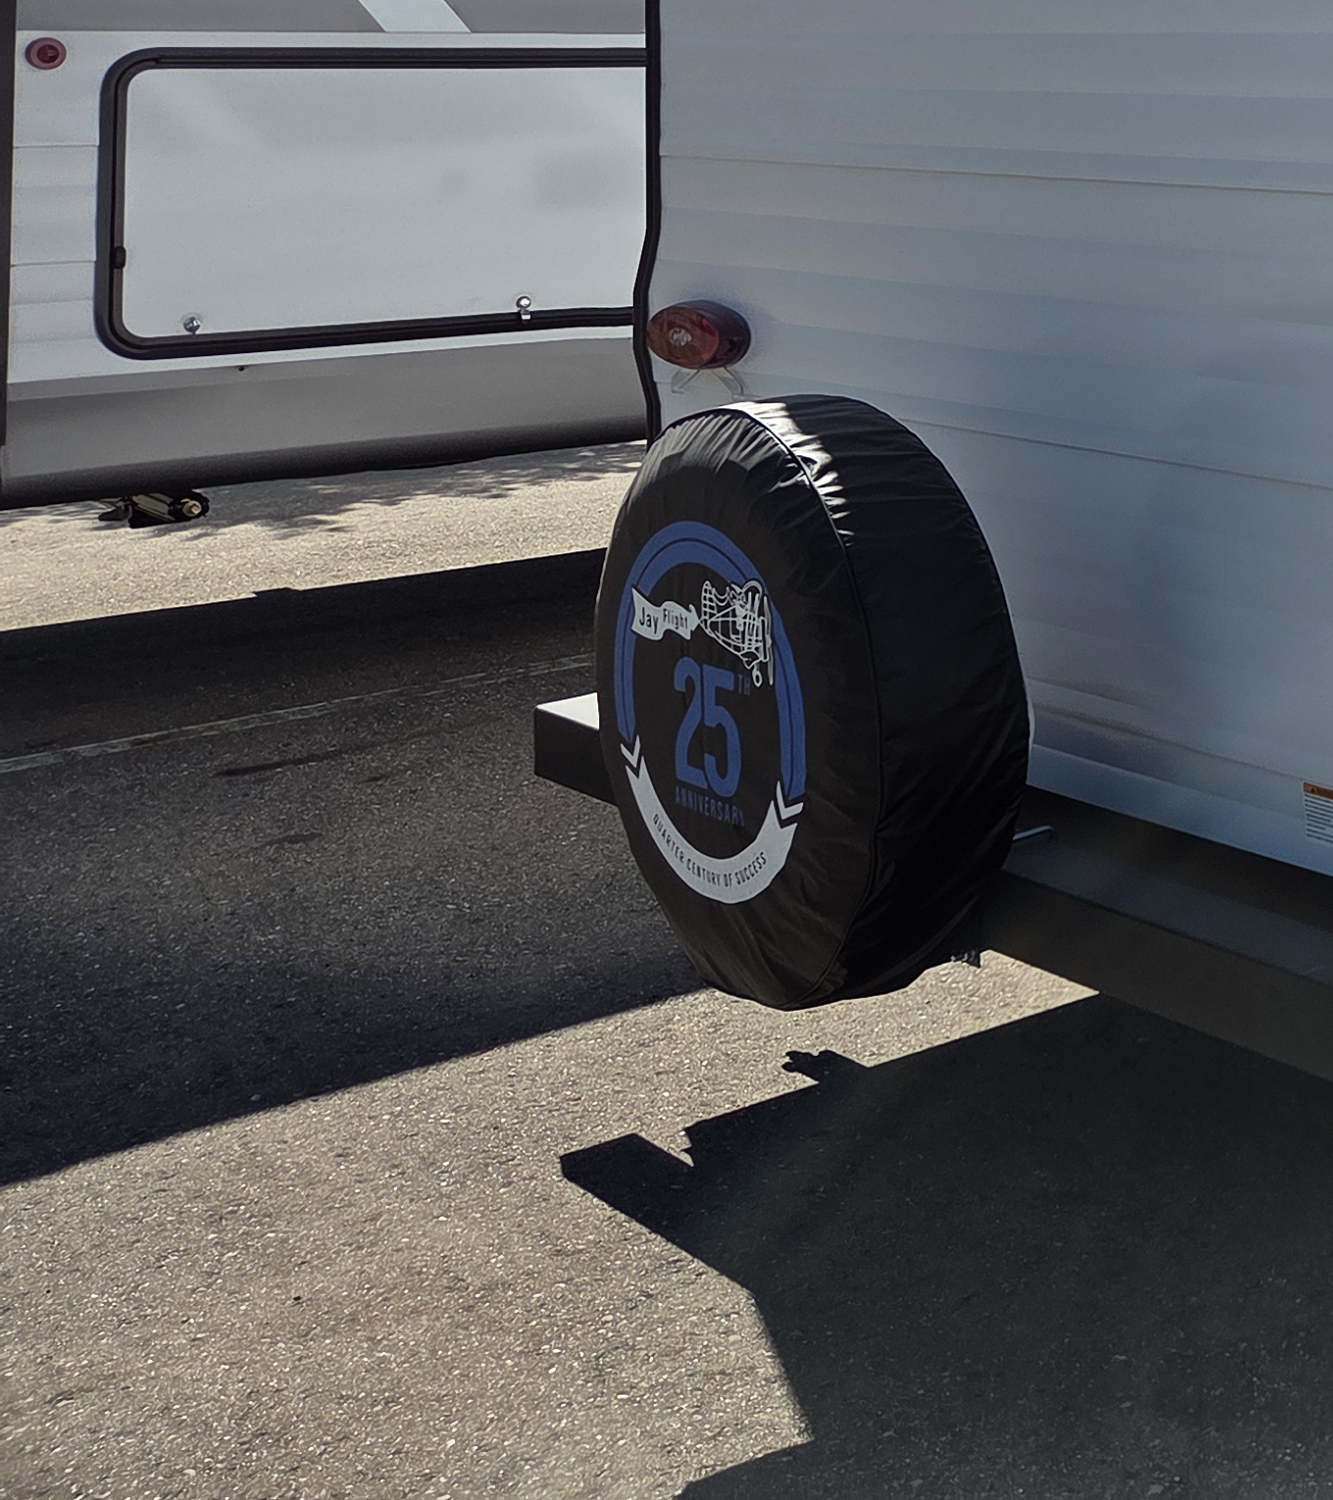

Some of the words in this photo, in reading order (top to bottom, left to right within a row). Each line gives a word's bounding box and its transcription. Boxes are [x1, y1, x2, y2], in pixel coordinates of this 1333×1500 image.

[638, 606, 659, 635] Jay
[662, 608, 689, 631] Flight
[675, 785, 745, 827] ANNIVERSARY
[653, 813, 684, 865] QUARTER
[686, 858, 721, 887] CENTURY
[723, 873, 733, 888] OF
[735, 851, 768, 886] SUCCESS
